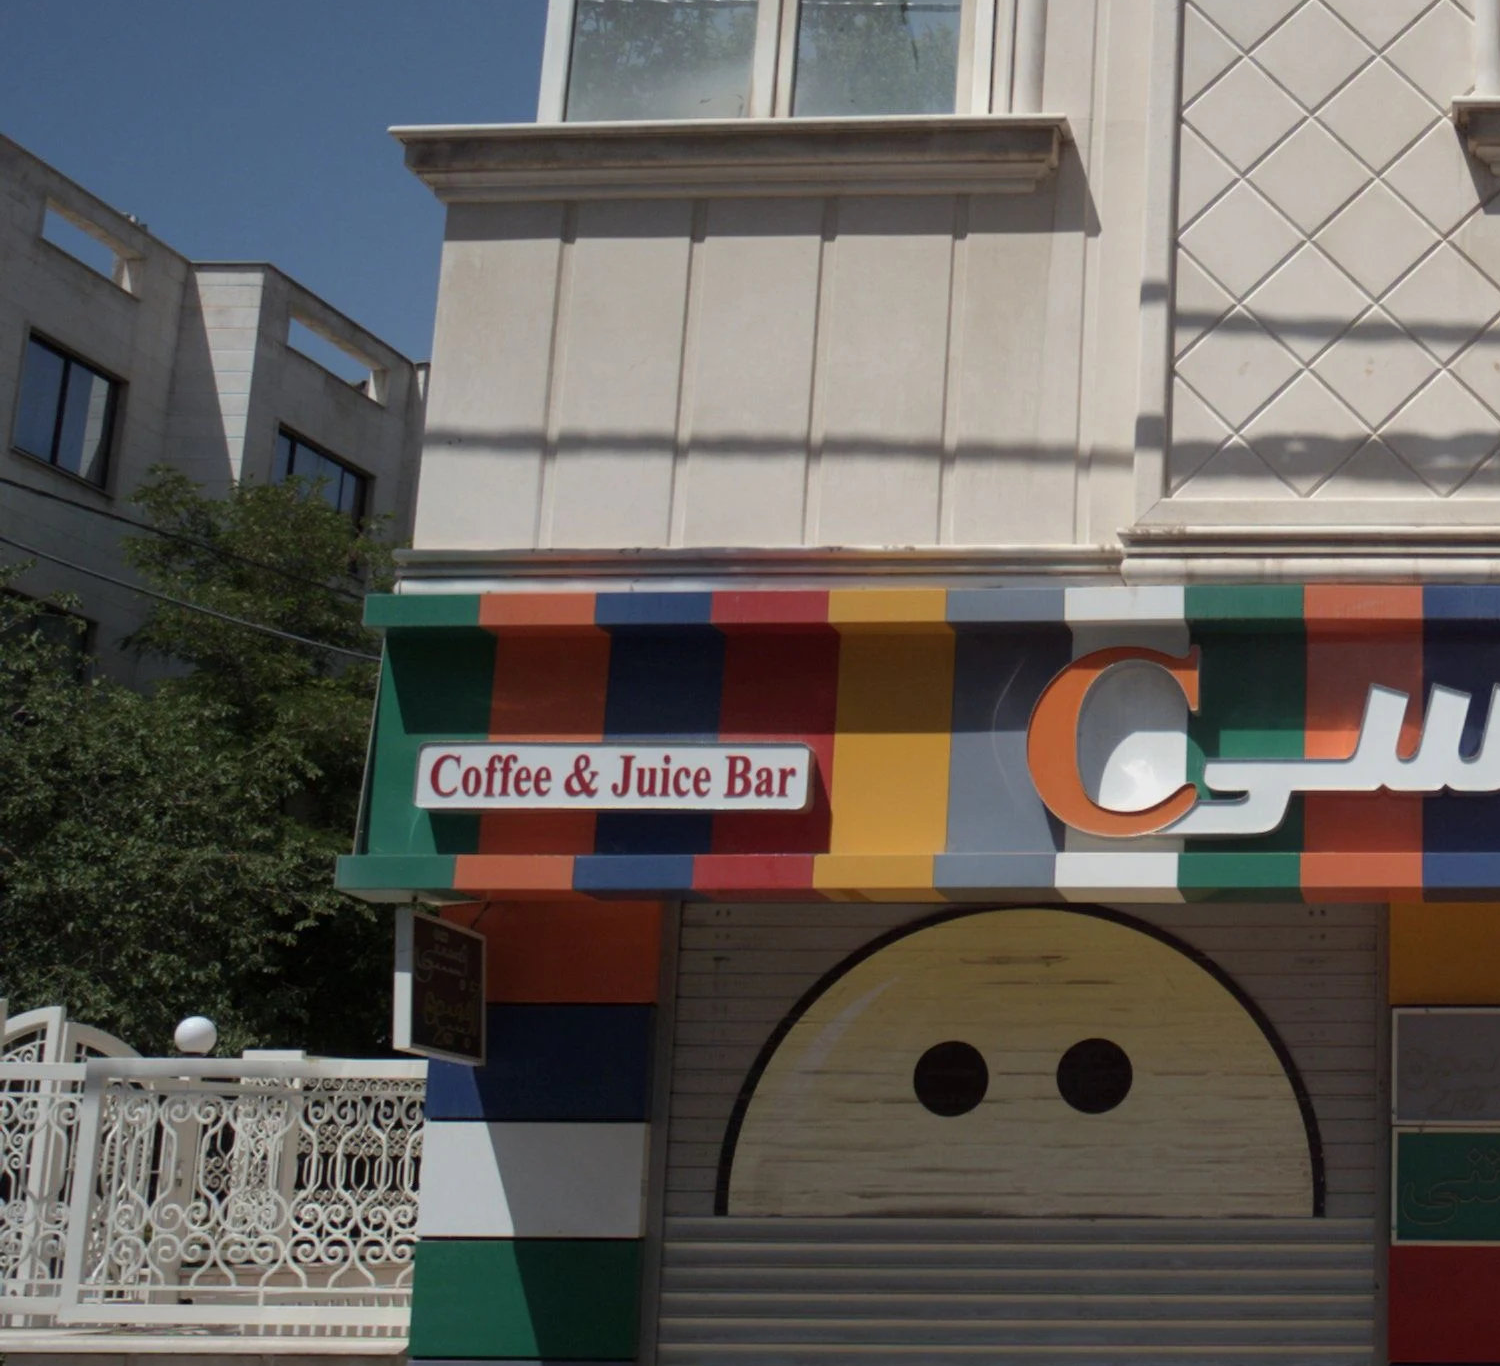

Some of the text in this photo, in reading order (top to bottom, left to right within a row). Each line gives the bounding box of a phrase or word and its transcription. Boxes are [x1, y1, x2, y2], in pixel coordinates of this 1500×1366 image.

[429, 752, 798, 798] Coffee & Juice Bar
